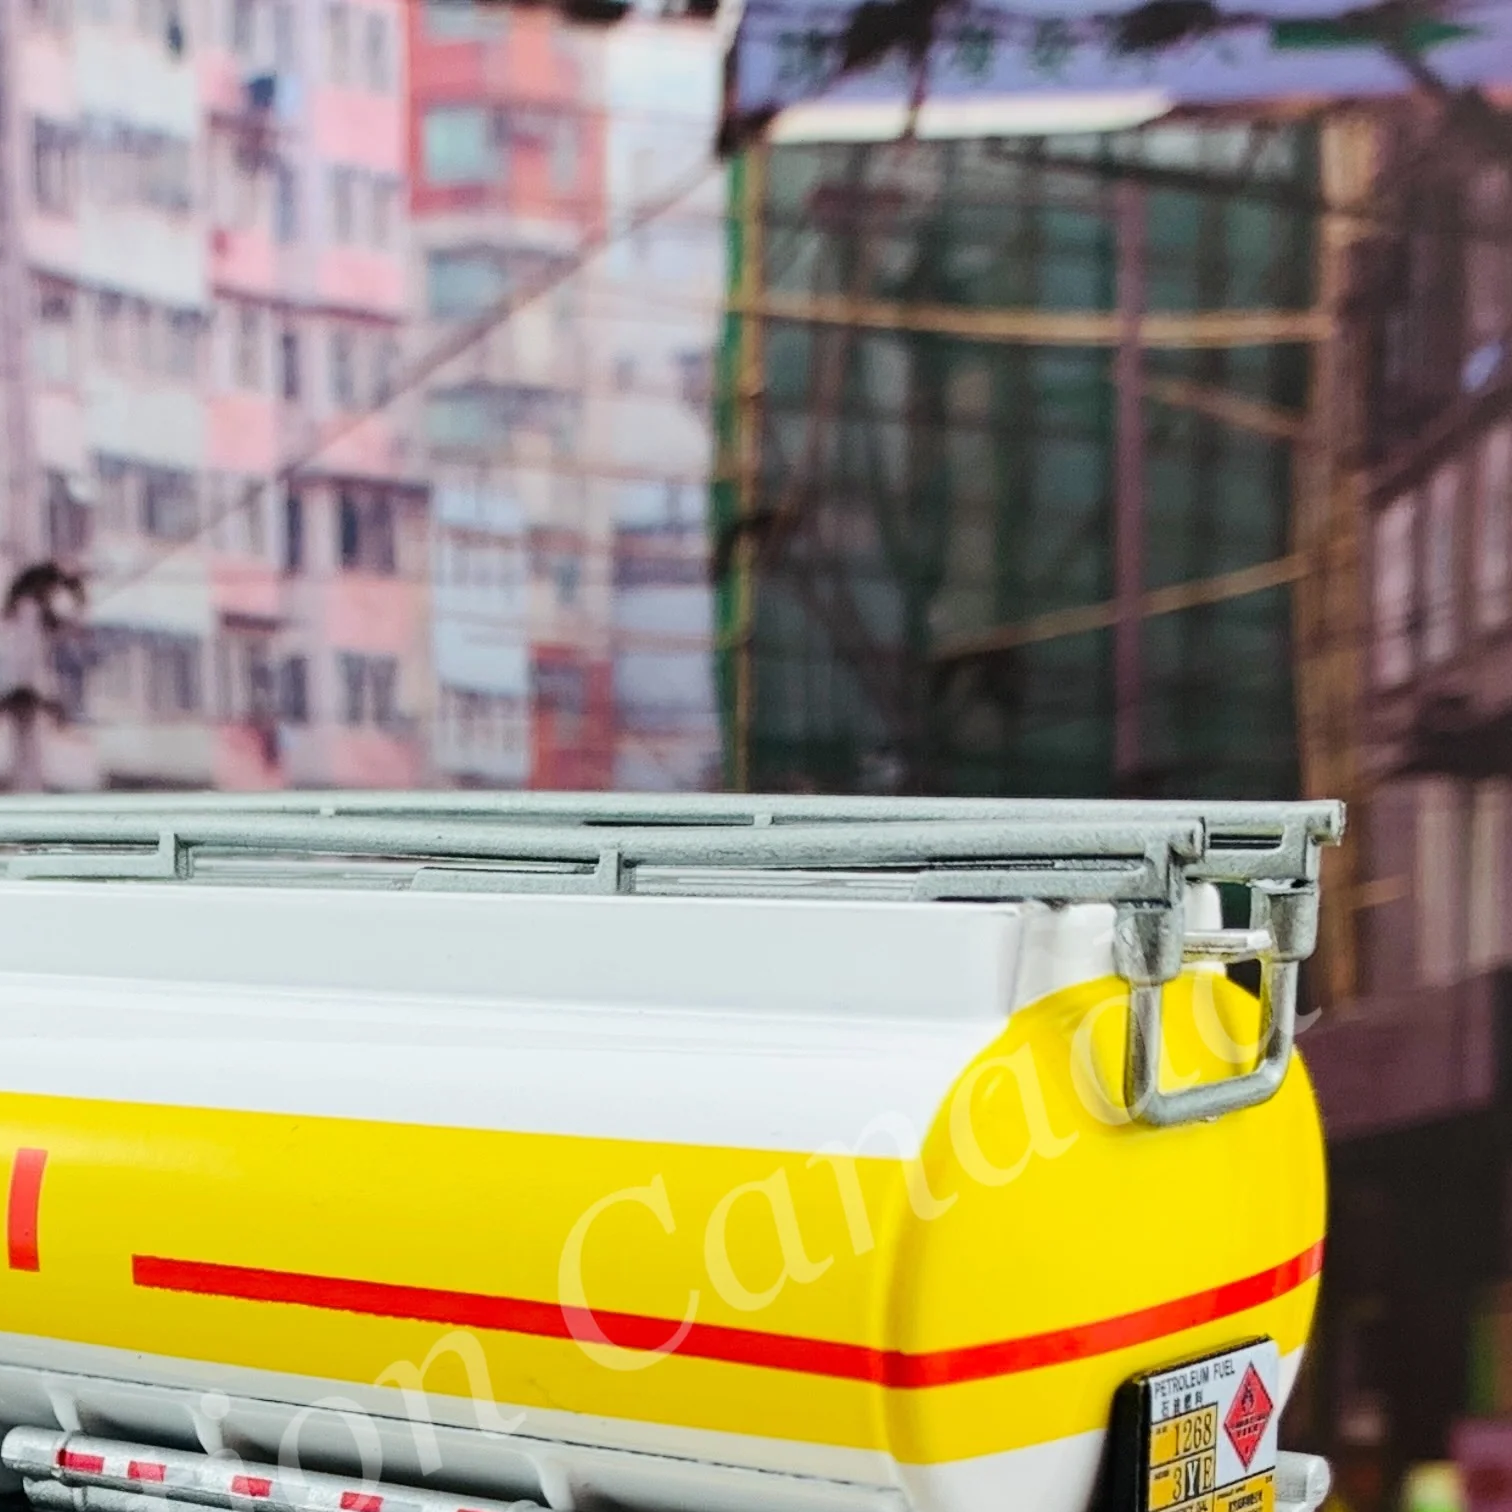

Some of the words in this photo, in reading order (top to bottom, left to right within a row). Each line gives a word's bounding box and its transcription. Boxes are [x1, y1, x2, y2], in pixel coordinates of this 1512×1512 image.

[1154, 1366, 1210, 1399] PETROLEUM
[1213, 1359, 1236, 1380] FUEL
[1174, 1412, 1212, 1457] 1268
